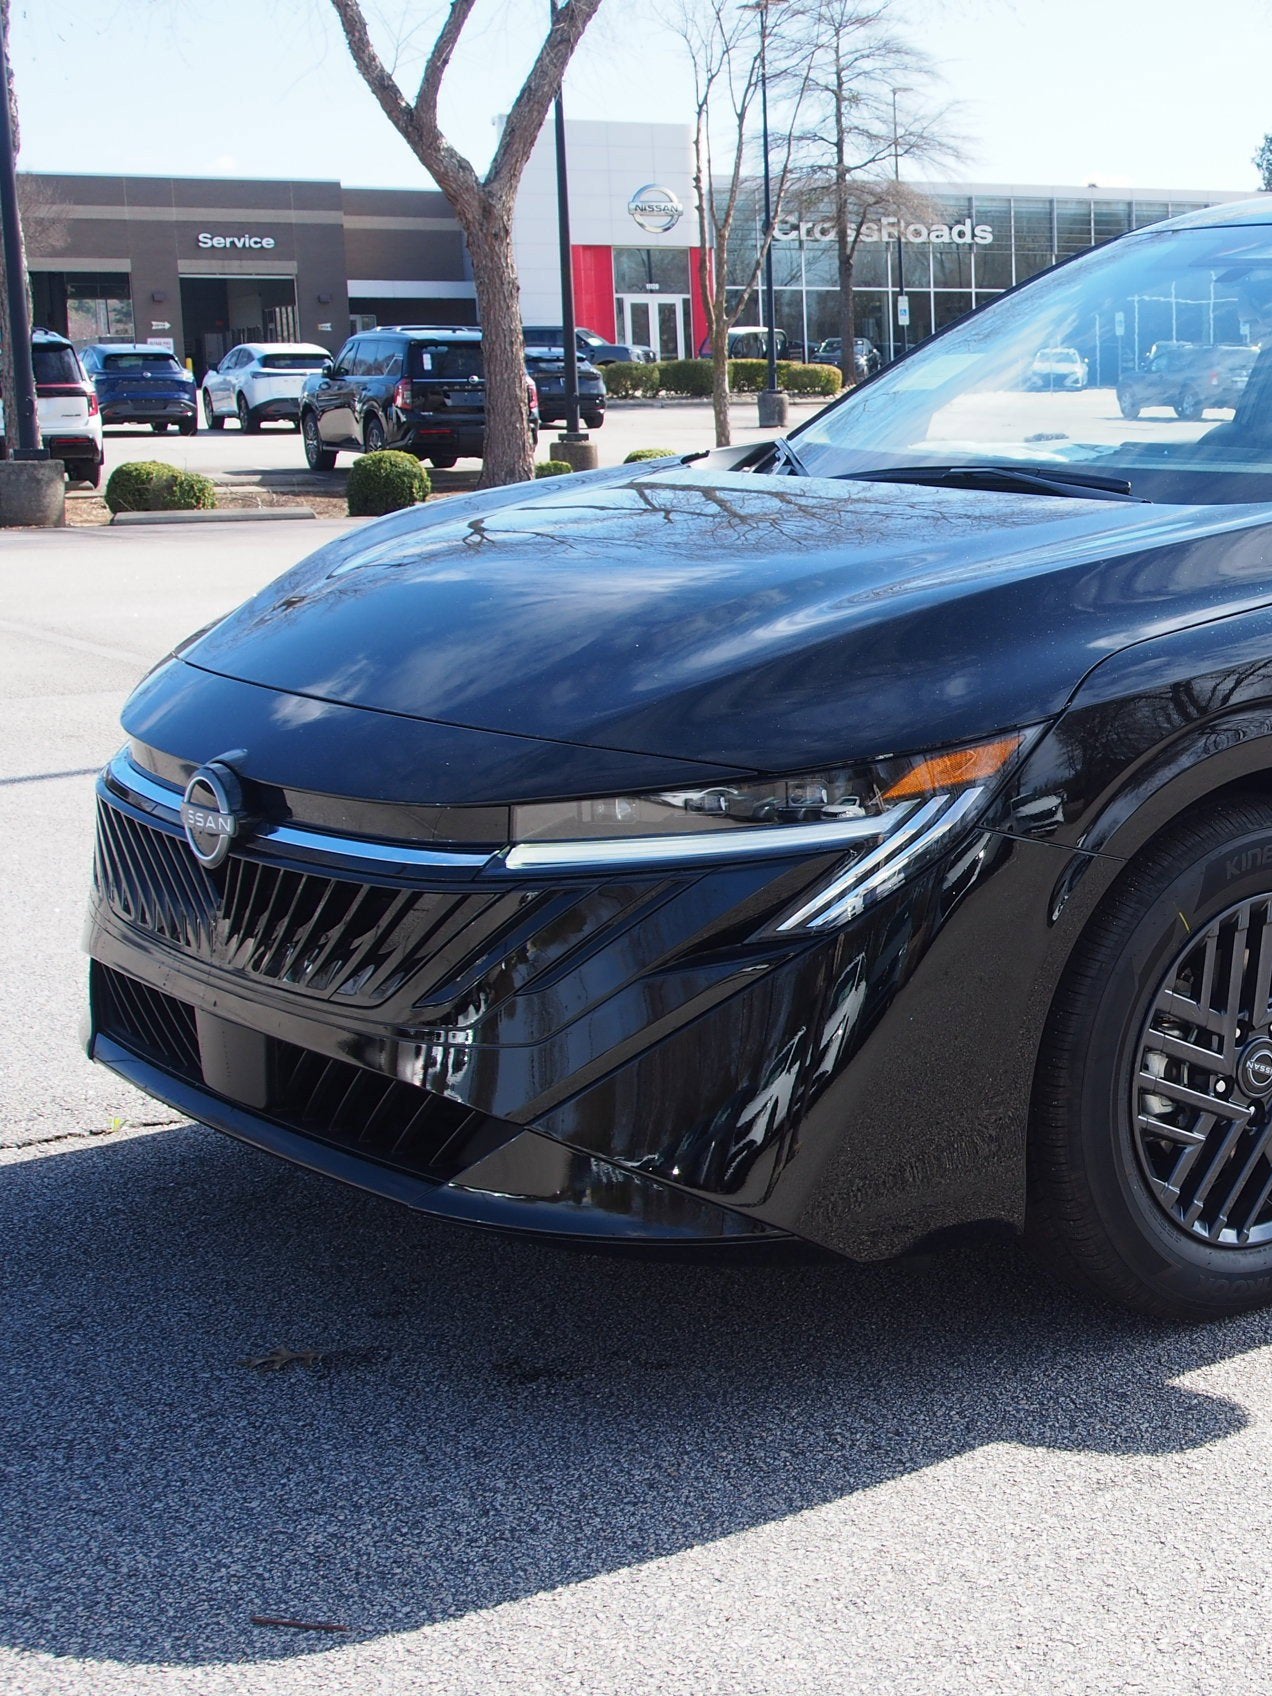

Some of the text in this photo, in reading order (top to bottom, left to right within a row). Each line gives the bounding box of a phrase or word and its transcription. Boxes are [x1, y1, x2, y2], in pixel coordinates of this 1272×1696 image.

[634, 204, 678, 213] NISSAN
[772, 217, 994, 245] CrossRoads
[198, 233, 275, 248] Service
[188, 810, 230, 831] SSAN
